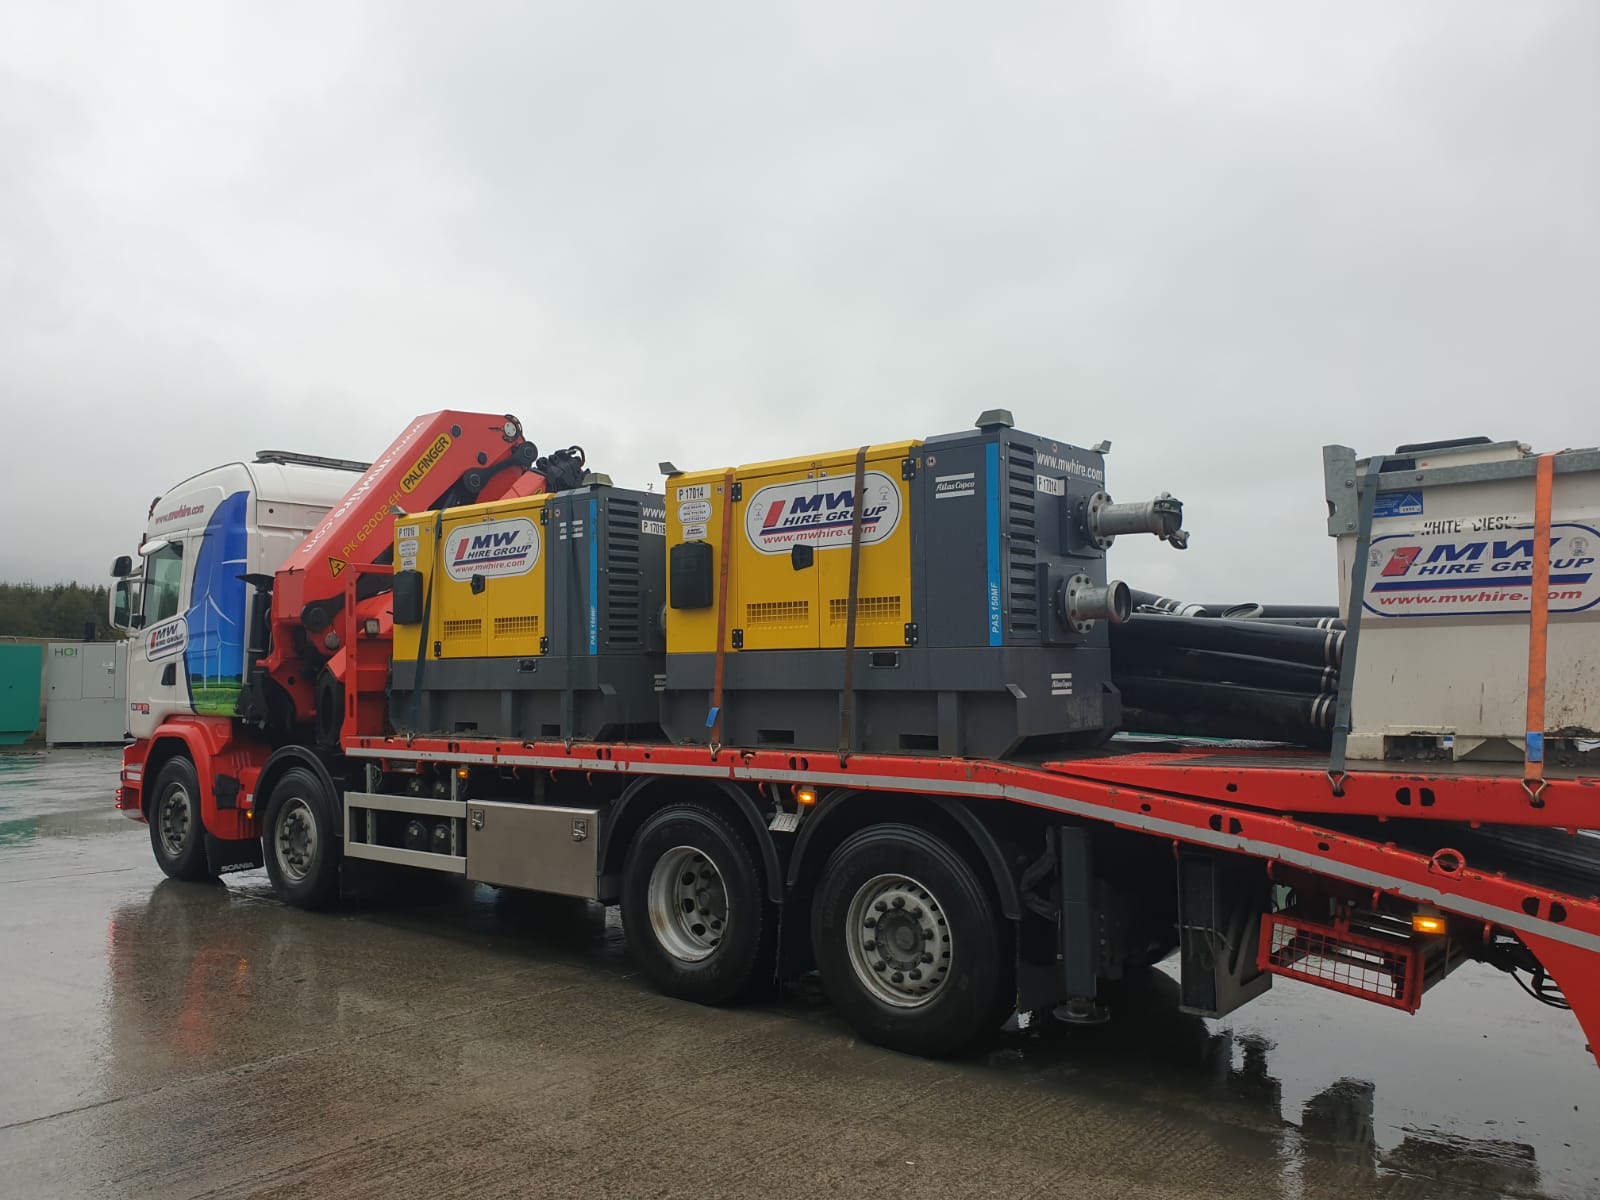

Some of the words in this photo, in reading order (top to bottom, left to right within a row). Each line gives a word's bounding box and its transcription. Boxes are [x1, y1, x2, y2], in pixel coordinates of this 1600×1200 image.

[403, 436, 449, 490] PALFINGER
[1036, 450, 1103, 481] www.mwhire.com
[679, 489, 684, 500] P
[686, 487, 704, 499] 17014
[936, 482, 955, 492] Atlas
[955, 481, 975, 491] Copco
[790, 488, 869, 514] MW
[643, 523, 648, 532] P
[783, 513, 824, 527] HIRE
[342, 542, 359, 558] PK
[356, 506, 391, 542] 62002
[472, 530, 520, 550] MW
[763, 525, 876, 545] www.mwhire.cm
[467, 549, 493, 559] HIRE
[493, 544, 532, 556] GROUP
[1426, 537, 1562, 564] MW
[455, 560, 525, 573] www.mwhire.com
[1418, 563, 1481, 575] HIRE
[1490, 557, 1595, 572] GRUP
[991, 582, 999, 611] 150MF
[1379, 591, 1582, 605] www.mwhire.om
[156, 623, 178, 641] MW
[220, 862, 255, 872] SCANIA
